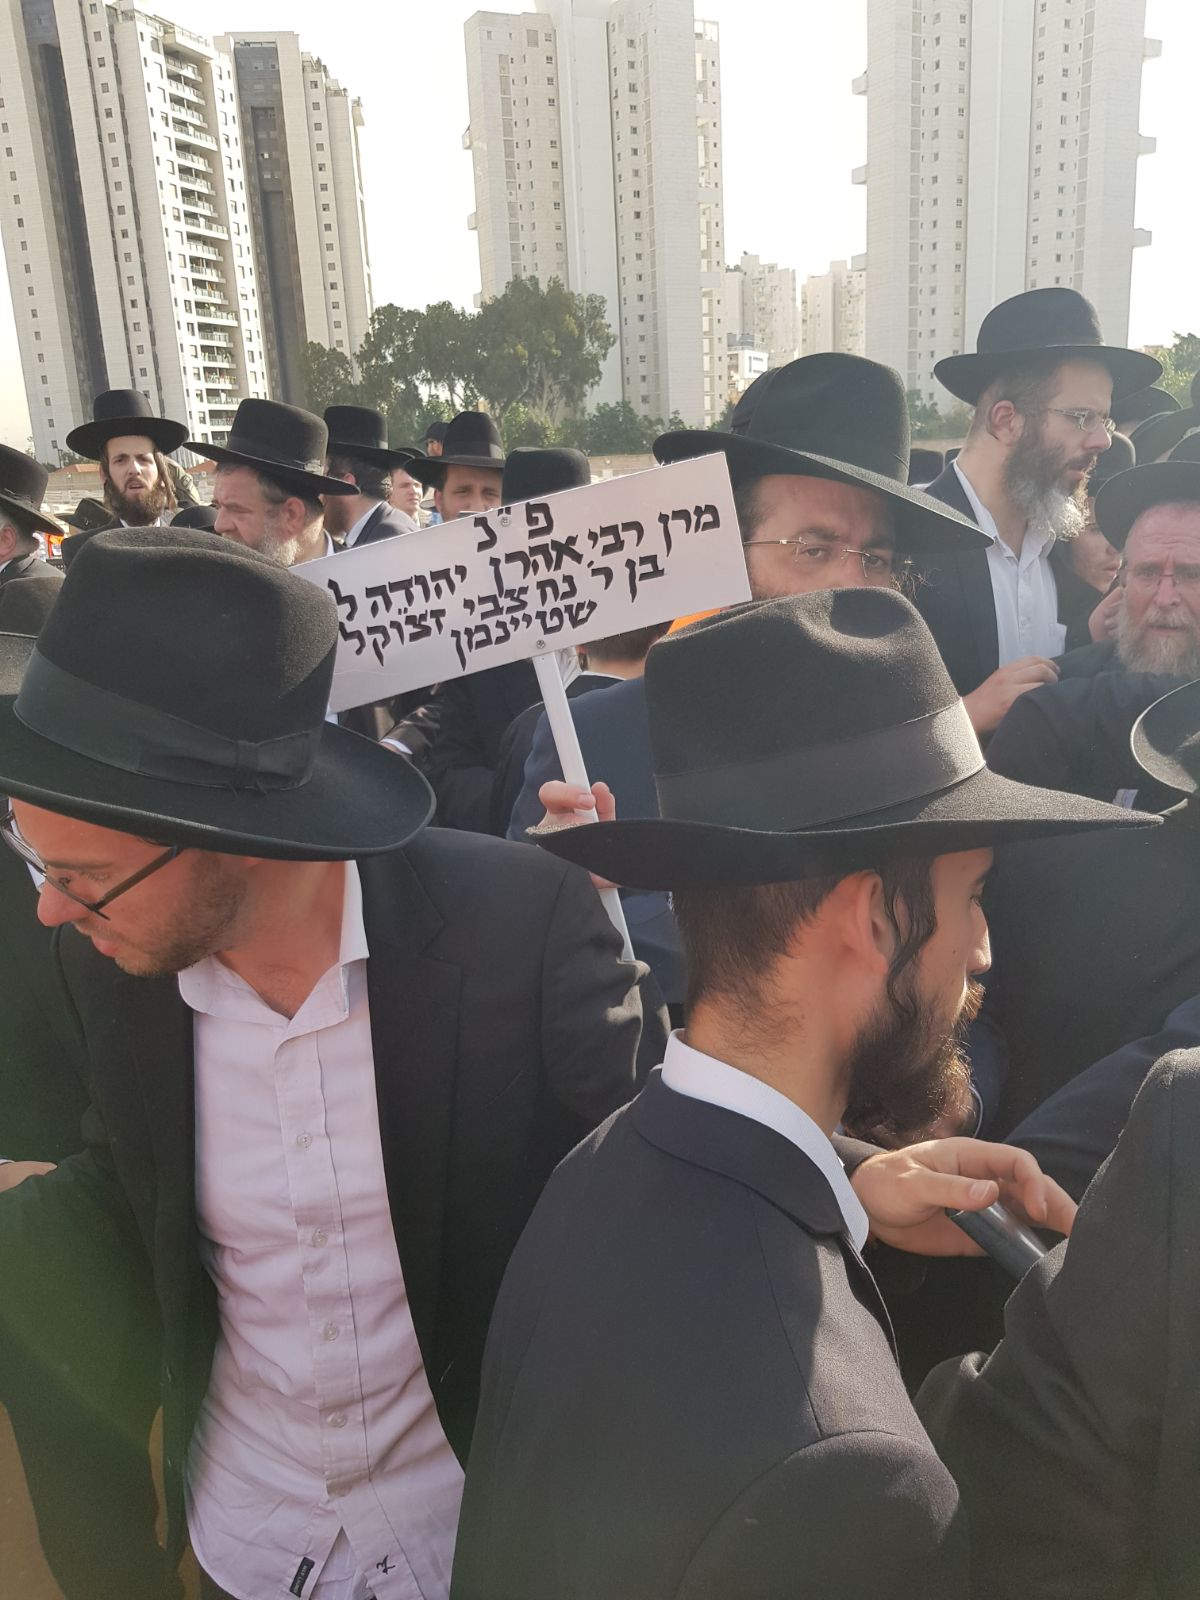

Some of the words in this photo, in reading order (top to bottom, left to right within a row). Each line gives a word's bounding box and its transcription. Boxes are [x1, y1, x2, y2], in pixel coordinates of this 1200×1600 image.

[588, 520, 644, 557] רבי
[658, 504, 720, 558] מרן
[365, 564, 467, 618] יהודה
[489, 534, 584, 600] אהרן
[536, 574, 577, 607] נח
[625, 554, 665, 603] בן
[463, 585, 529, 621] צבי
[451, 599, 598, 672] שטיינמן
